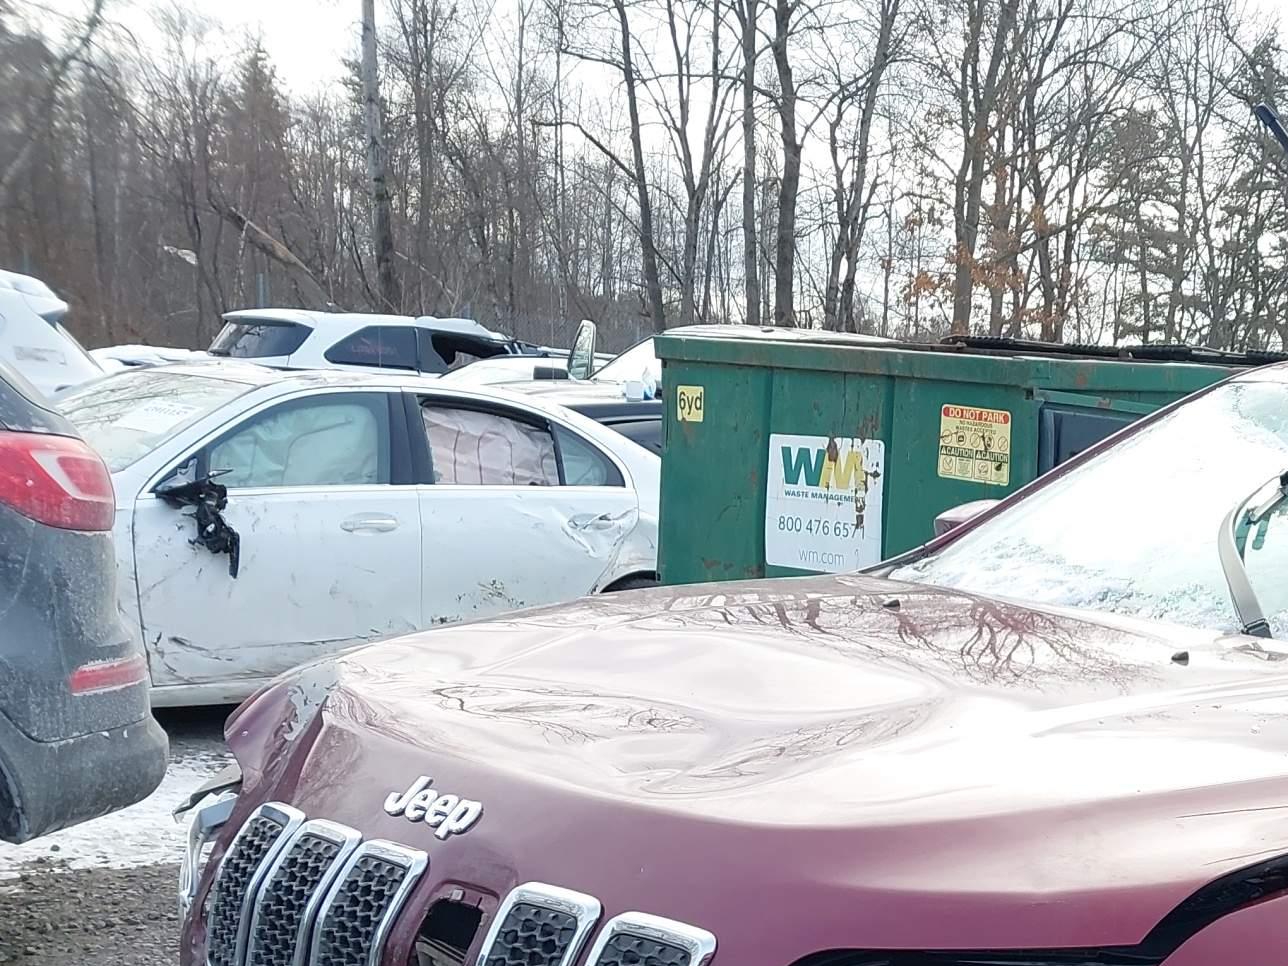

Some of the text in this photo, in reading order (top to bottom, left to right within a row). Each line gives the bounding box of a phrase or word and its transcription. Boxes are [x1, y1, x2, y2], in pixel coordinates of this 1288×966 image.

[679, 391, 703, 415] 6yd
[949, 407, 1004, 424] DO NOT PARK
[946, 447, 973, 458] CAUTION
[982, 452, 1008, 463] CAUTION
[781, 446, 865, 490] WM
[784, 489, 866, 503] WASTE MANAGEME
[778, 515, 802, 532] 800
[805, 519, 830, 536] 476
[799, 548, 845, 566] wm.com
[383, 775, 483, 840] Jeep
